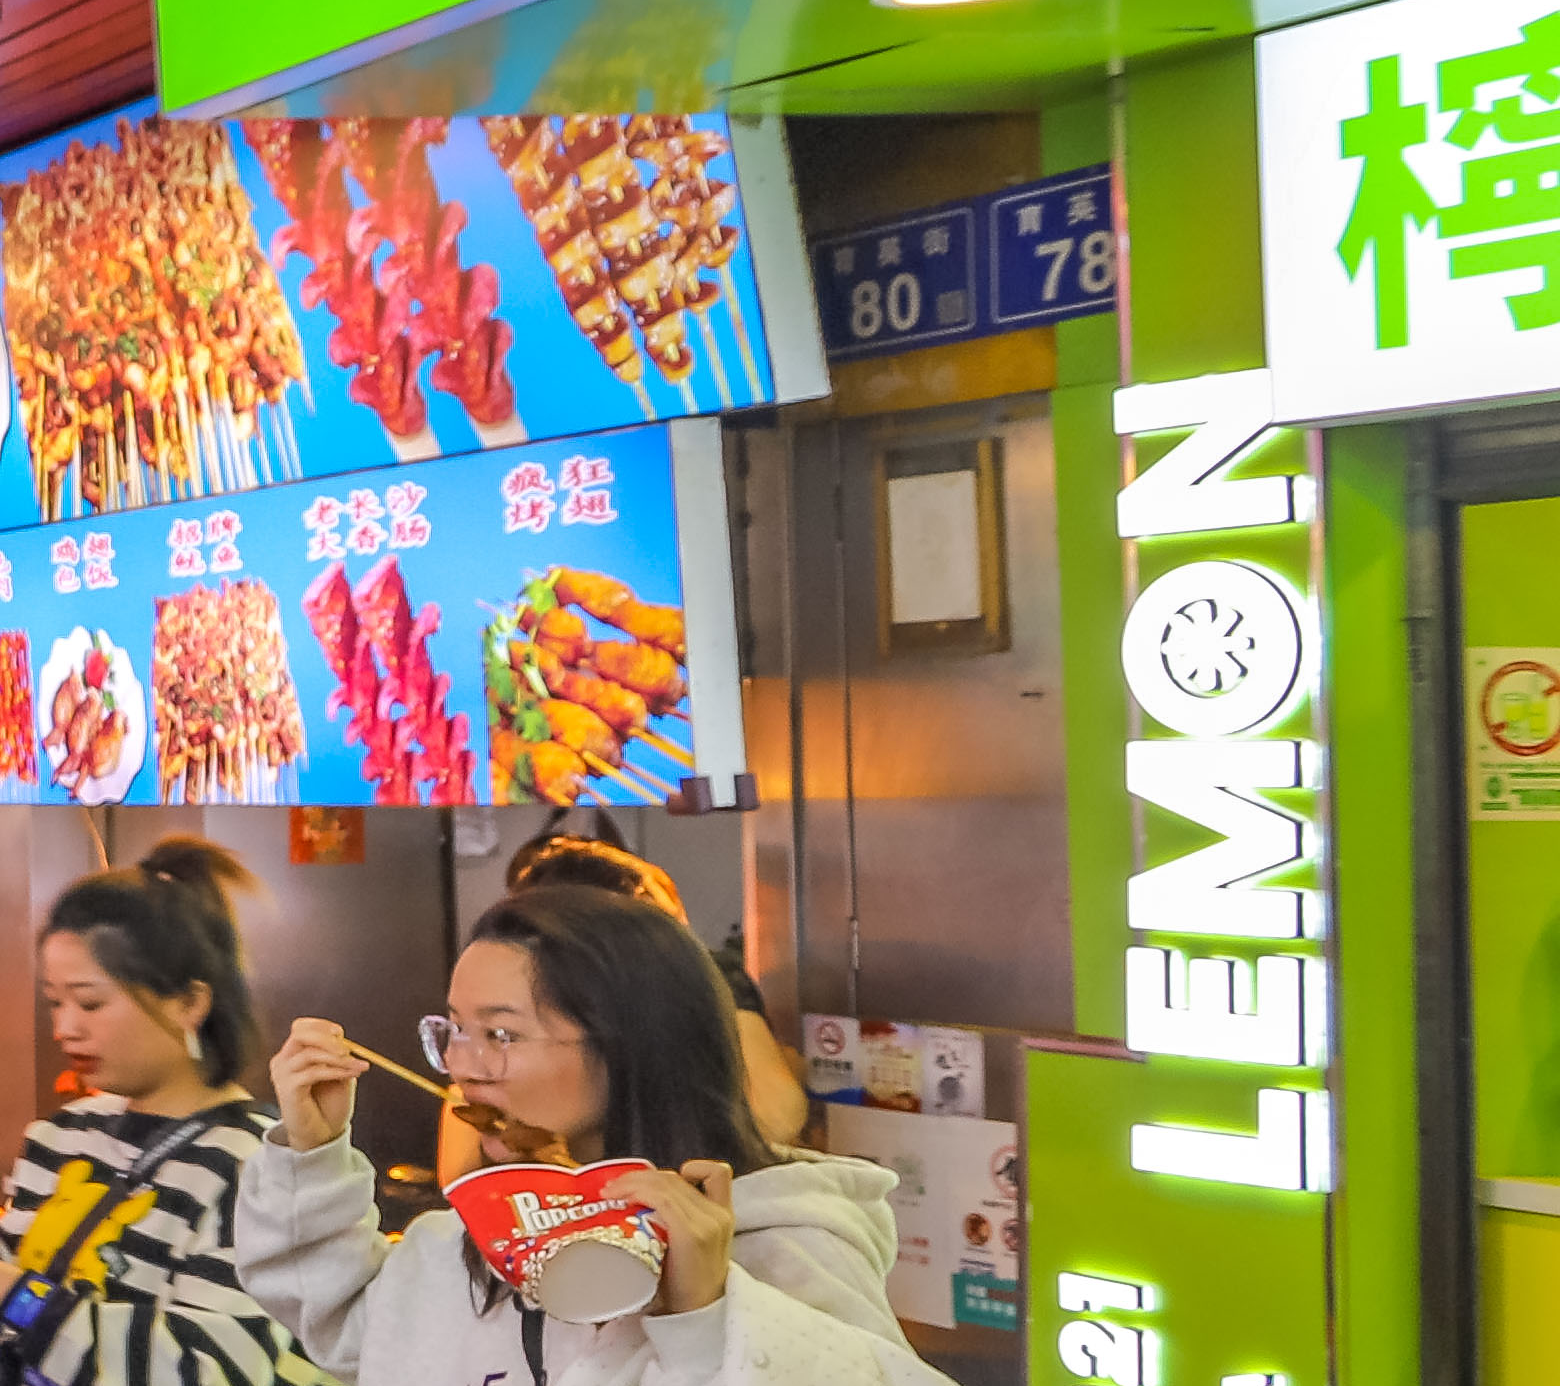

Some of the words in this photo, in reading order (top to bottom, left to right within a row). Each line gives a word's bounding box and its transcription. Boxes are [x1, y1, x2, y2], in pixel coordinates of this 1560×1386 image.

[1035, 229, 1115, 303] 78
[851, 271, 923, 339] 80
[502, 454, 617, 501] 疯狂
[303, 481, 428, 529] 老长沙
[168, 510, 242, 548] 招牌
[306, 517, 431, 562] 大香肠
